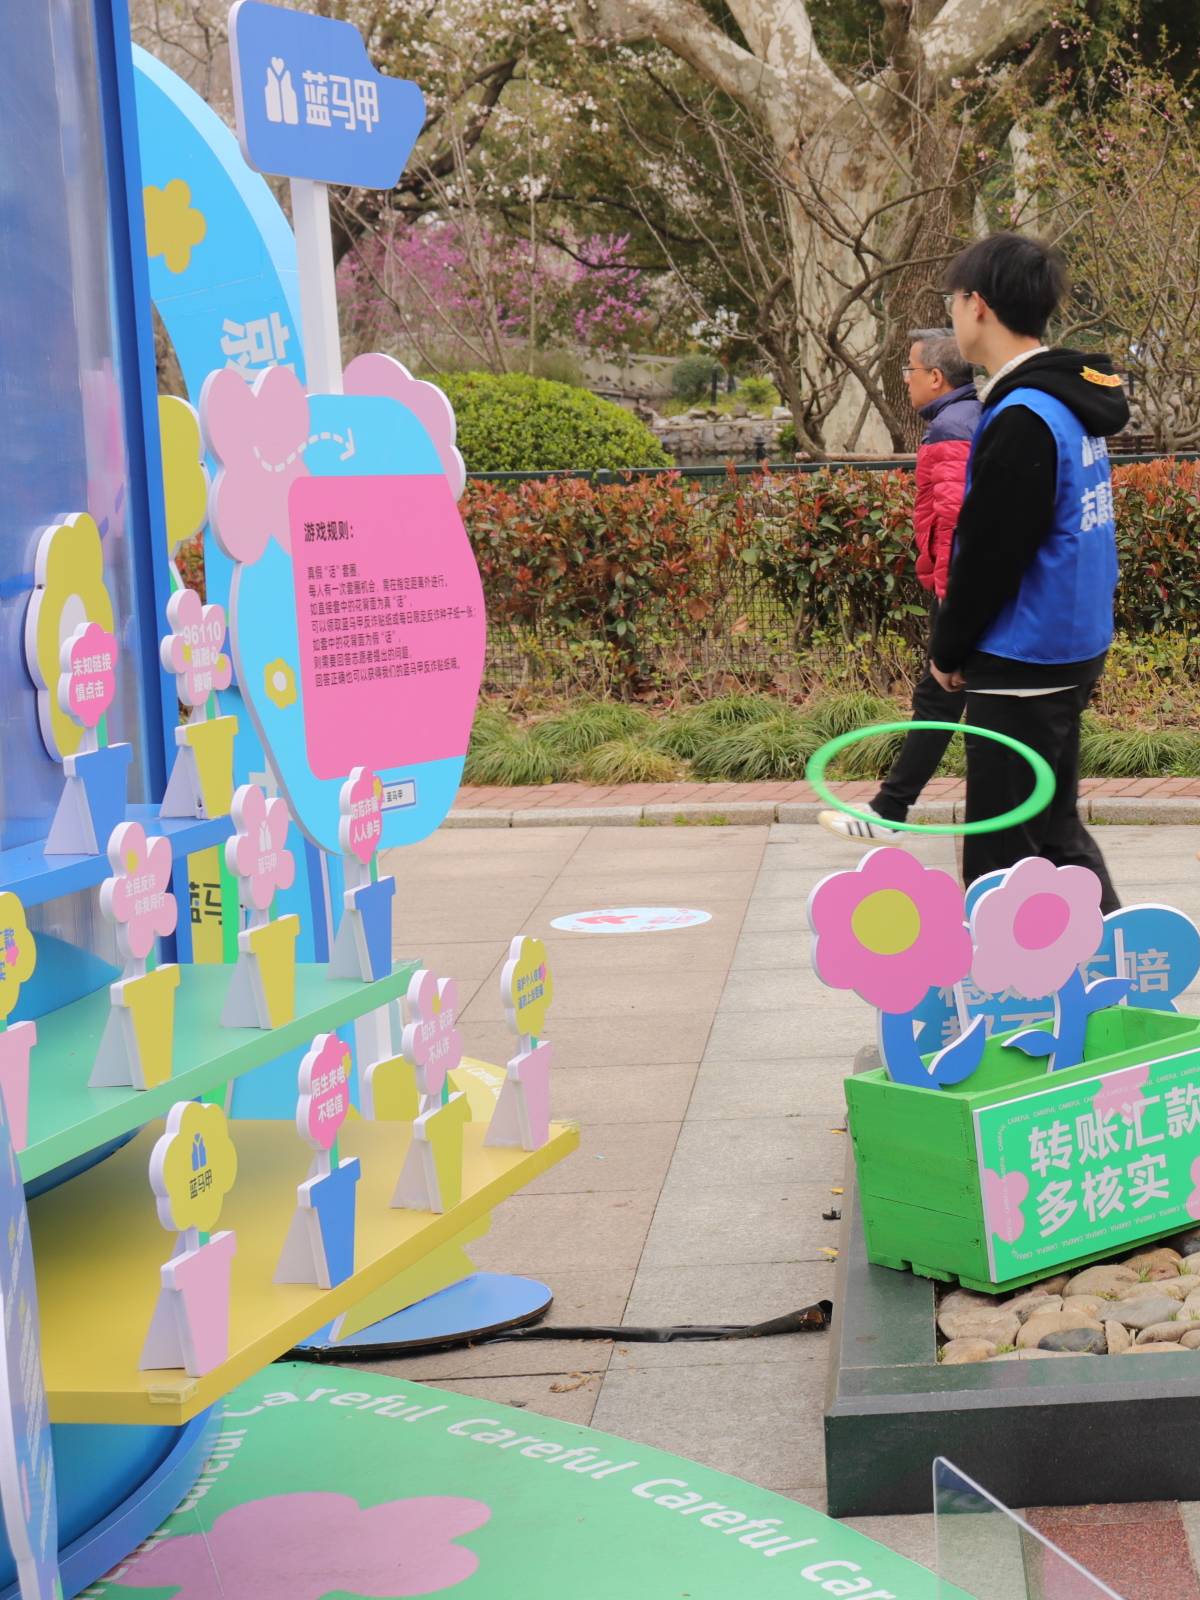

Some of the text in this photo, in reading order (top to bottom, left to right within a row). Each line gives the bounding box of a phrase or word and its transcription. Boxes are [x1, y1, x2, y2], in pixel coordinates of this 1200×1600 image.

[302, 69, 379, 134] 蓝马甲
[304, 520, 354, 542] 游戏规则：
[183, 622, 221, 646] 96110
[72, 653, 113, 676] 未知链接
[75, 681, 105, 702] 慎点击
[311, 1064, 347, 1100] 陌生来电
[317, 1093, 344, 1124] 不轻信
[189, 1169, 213, 1200] 蓝马甲
[1036, 1153, 1170, 1238] 多核实
[223, 1388, 897, 1600] Careful Careful Careful Car
